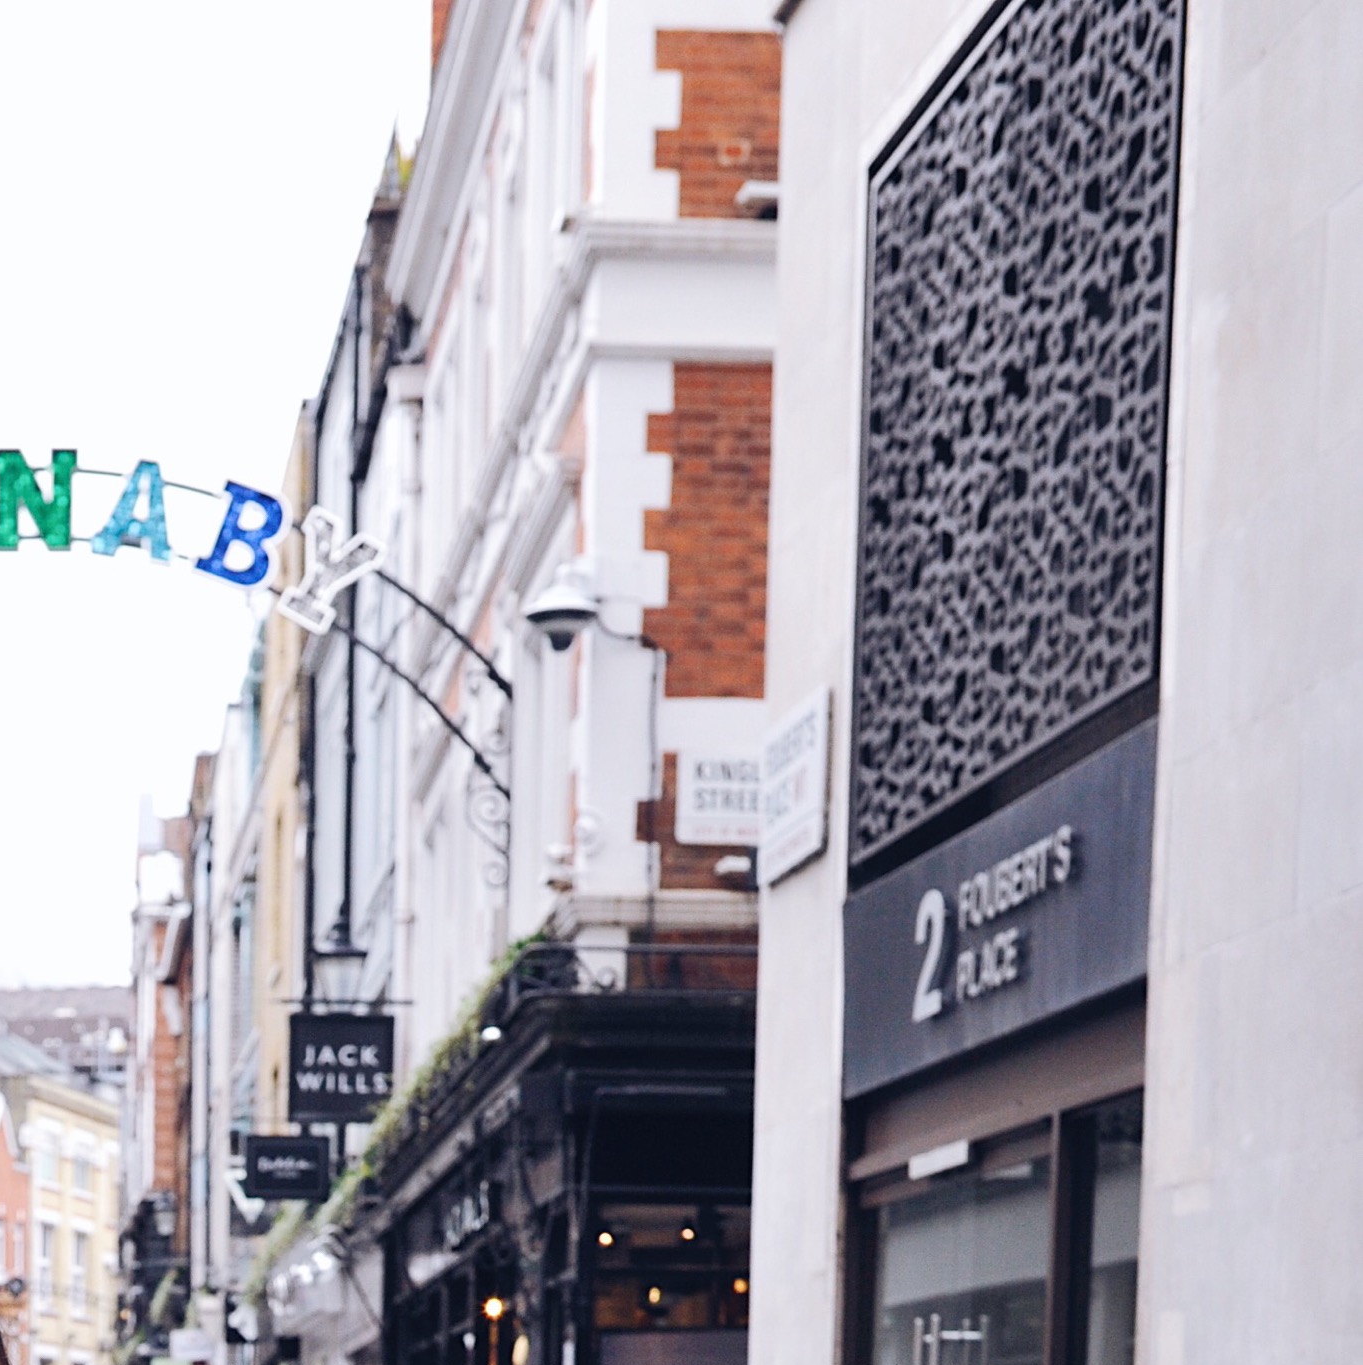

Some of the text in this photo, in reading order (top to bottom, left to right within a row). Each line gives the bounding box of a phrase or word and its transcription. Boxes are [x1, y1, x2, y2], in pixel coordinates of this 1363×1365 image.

[695, 759, 759, 782] KINGL
[695, 787, 759, 812] STREE
[959, 824, 1072, 931] FOUBERT'S
[912, 888, 945, 1023] 2
[956, 927, 1019, 1002] PLACE
[302, 1044, 380, 1067] JACK
[295, 1072, 389, 1094] WILLS
